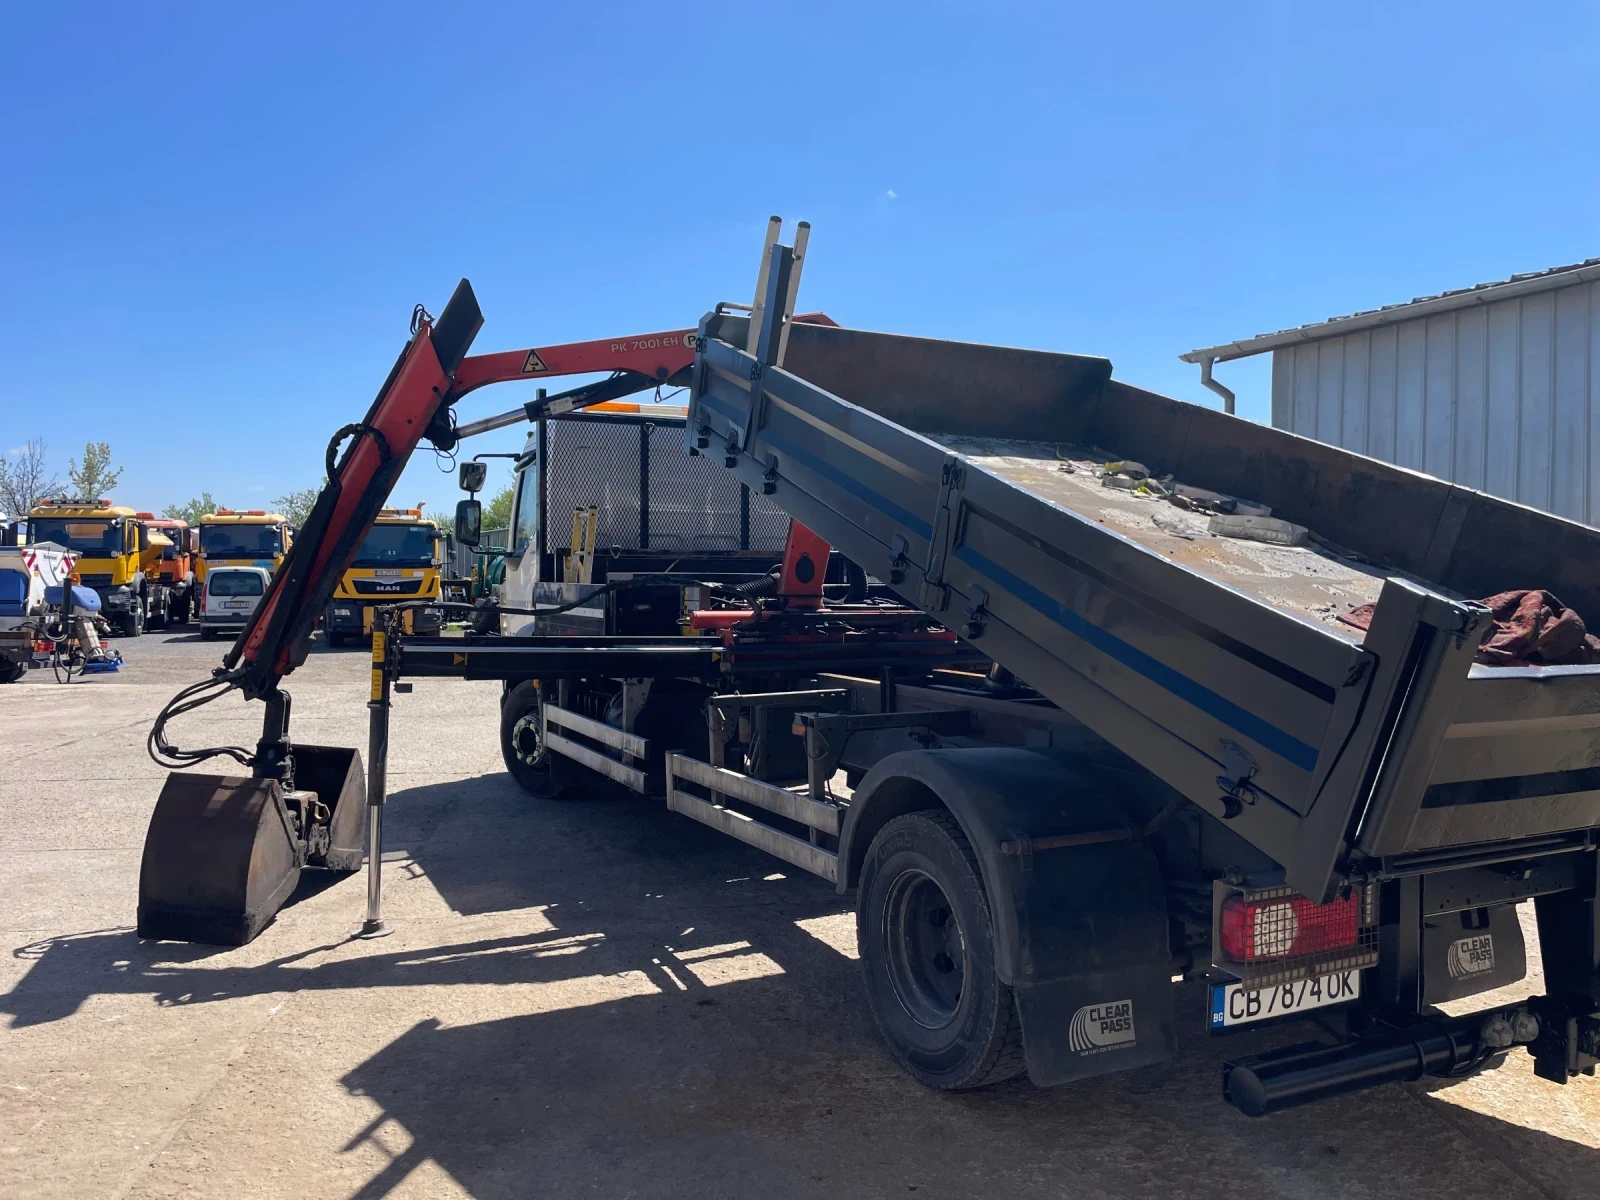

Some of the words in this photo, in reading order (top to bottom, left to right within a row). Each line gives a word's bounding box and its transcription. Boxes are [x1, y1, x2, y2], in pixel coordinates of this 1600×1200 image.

[611, 342, 627, 353] PK
[1461, 937, 1491, 954] CLEAR
[1469, 949, 1493, 964] PASS
[1229, 987, 1262, 1020] CB
[1327, 971, 1354, 999] OK
[1089, 1003, 1129, 1022] CLEAR
[1213, 1012, 1224, 1023] BG
[1100, 1017, 1131, 1034] PASS
